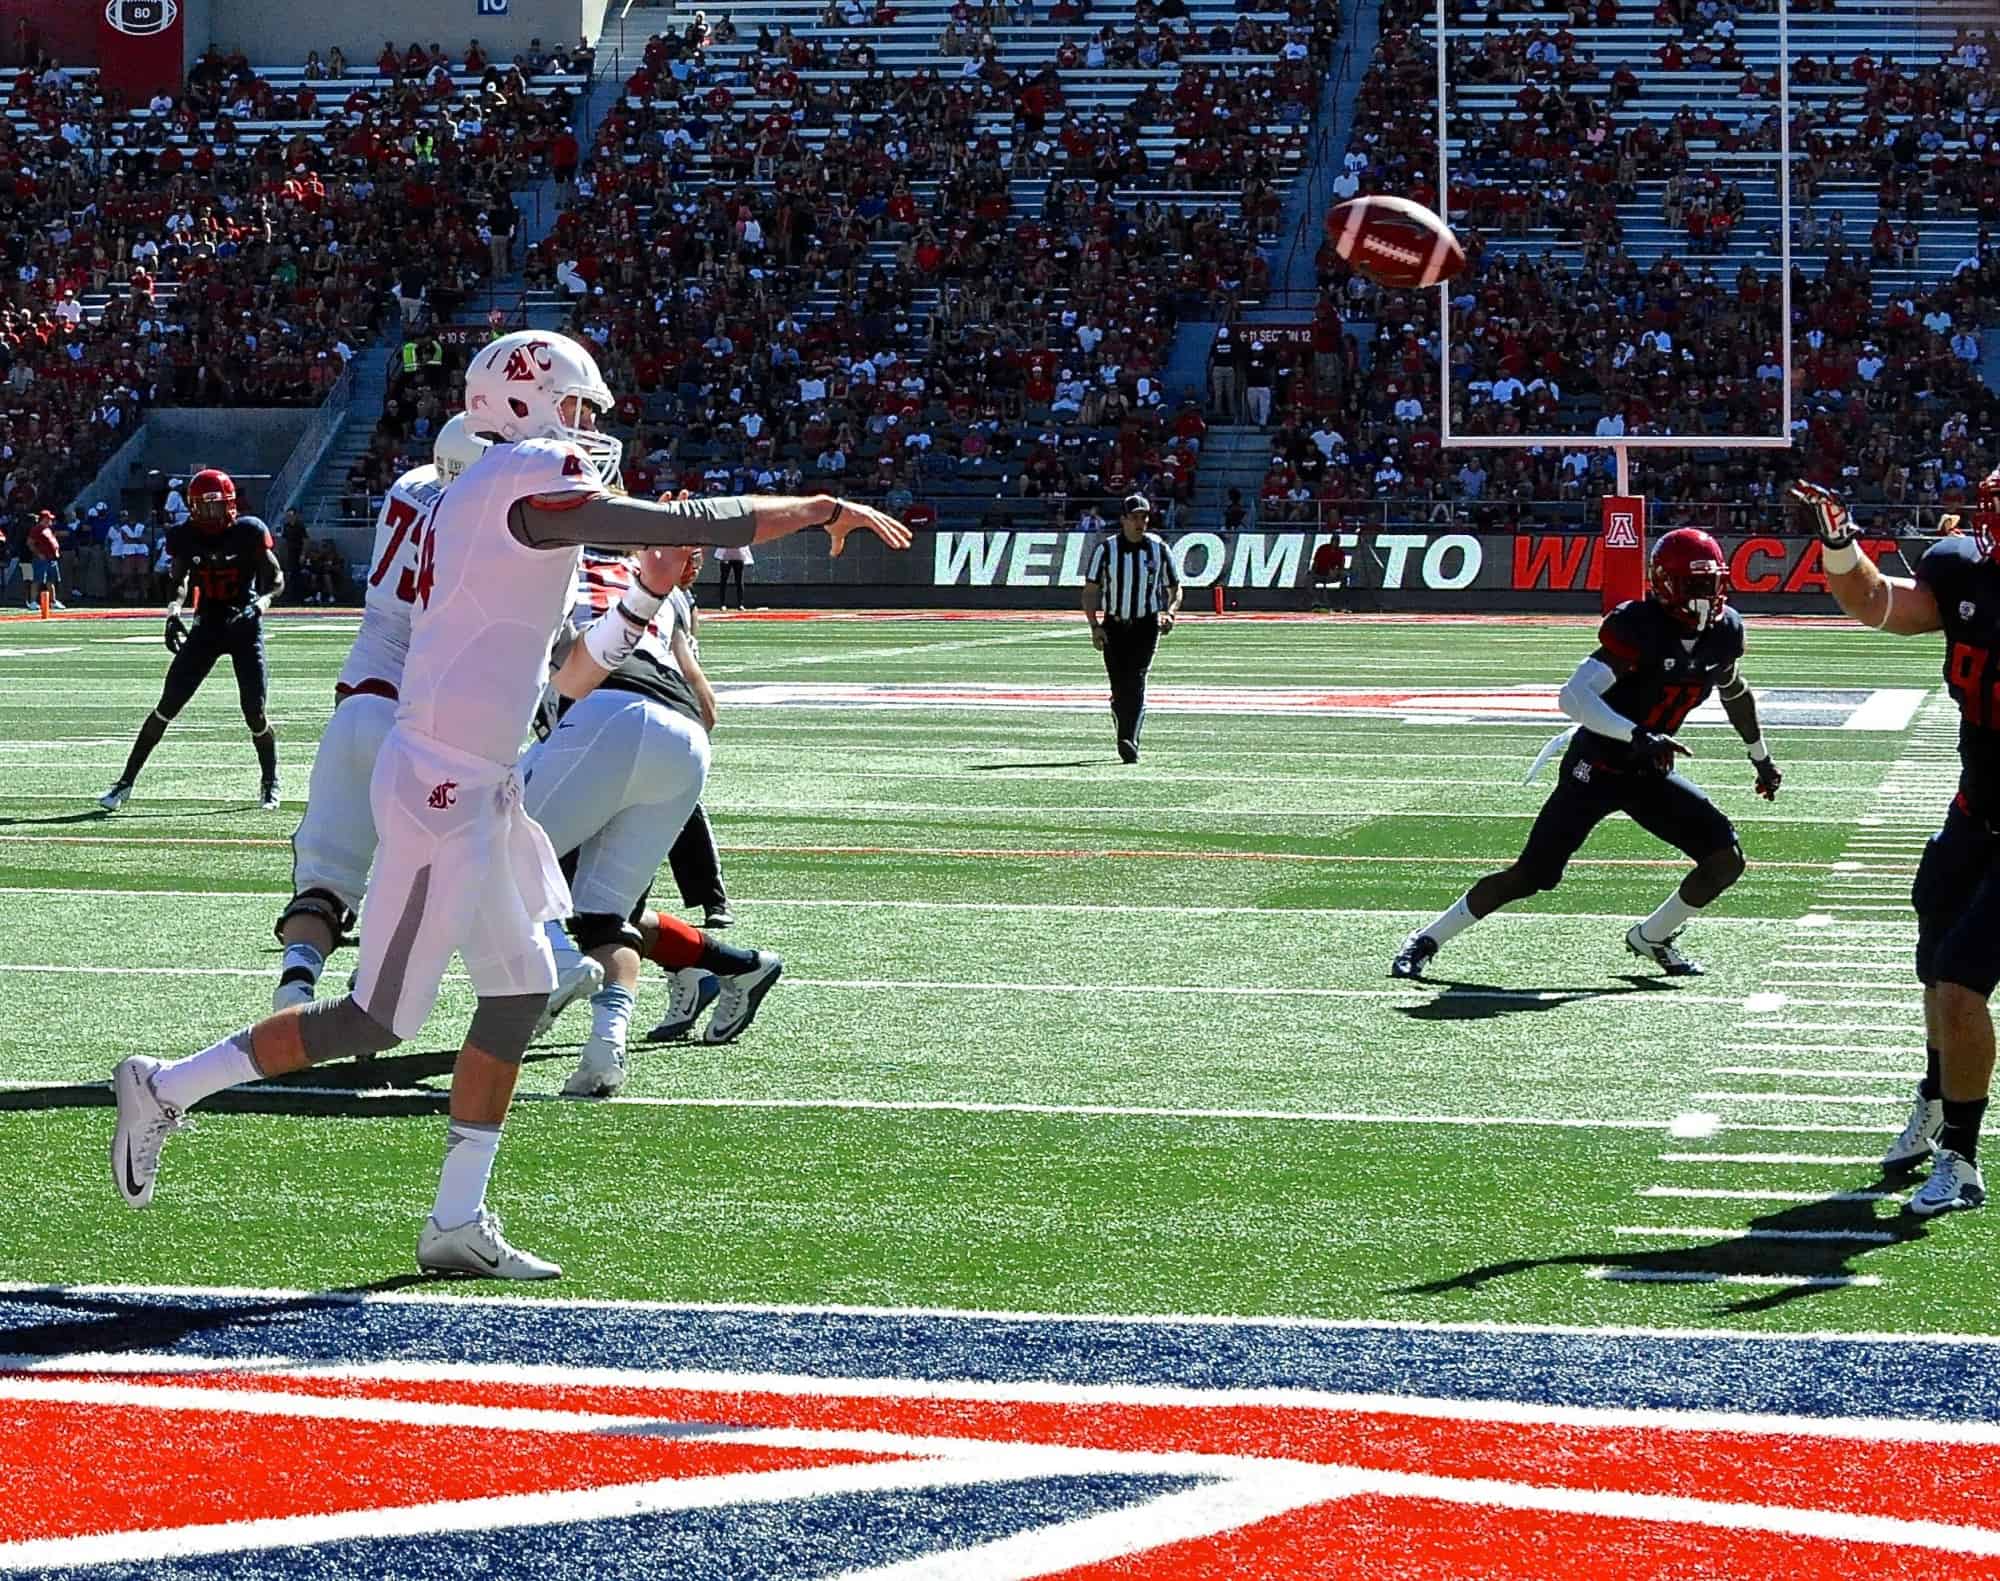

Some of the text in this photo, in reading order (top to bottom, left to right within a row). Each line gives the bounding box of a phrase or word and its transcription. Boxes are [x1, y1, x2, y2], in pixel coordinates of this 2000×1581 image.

[134, 7, 151, 18] 80
[1605, 512, 1638, 548] A
[934, 532, 1898, 593] WELOME TO WICA
[1643, 685, 1704, 731] 11
[1951, 641, 2000, 729] 9
